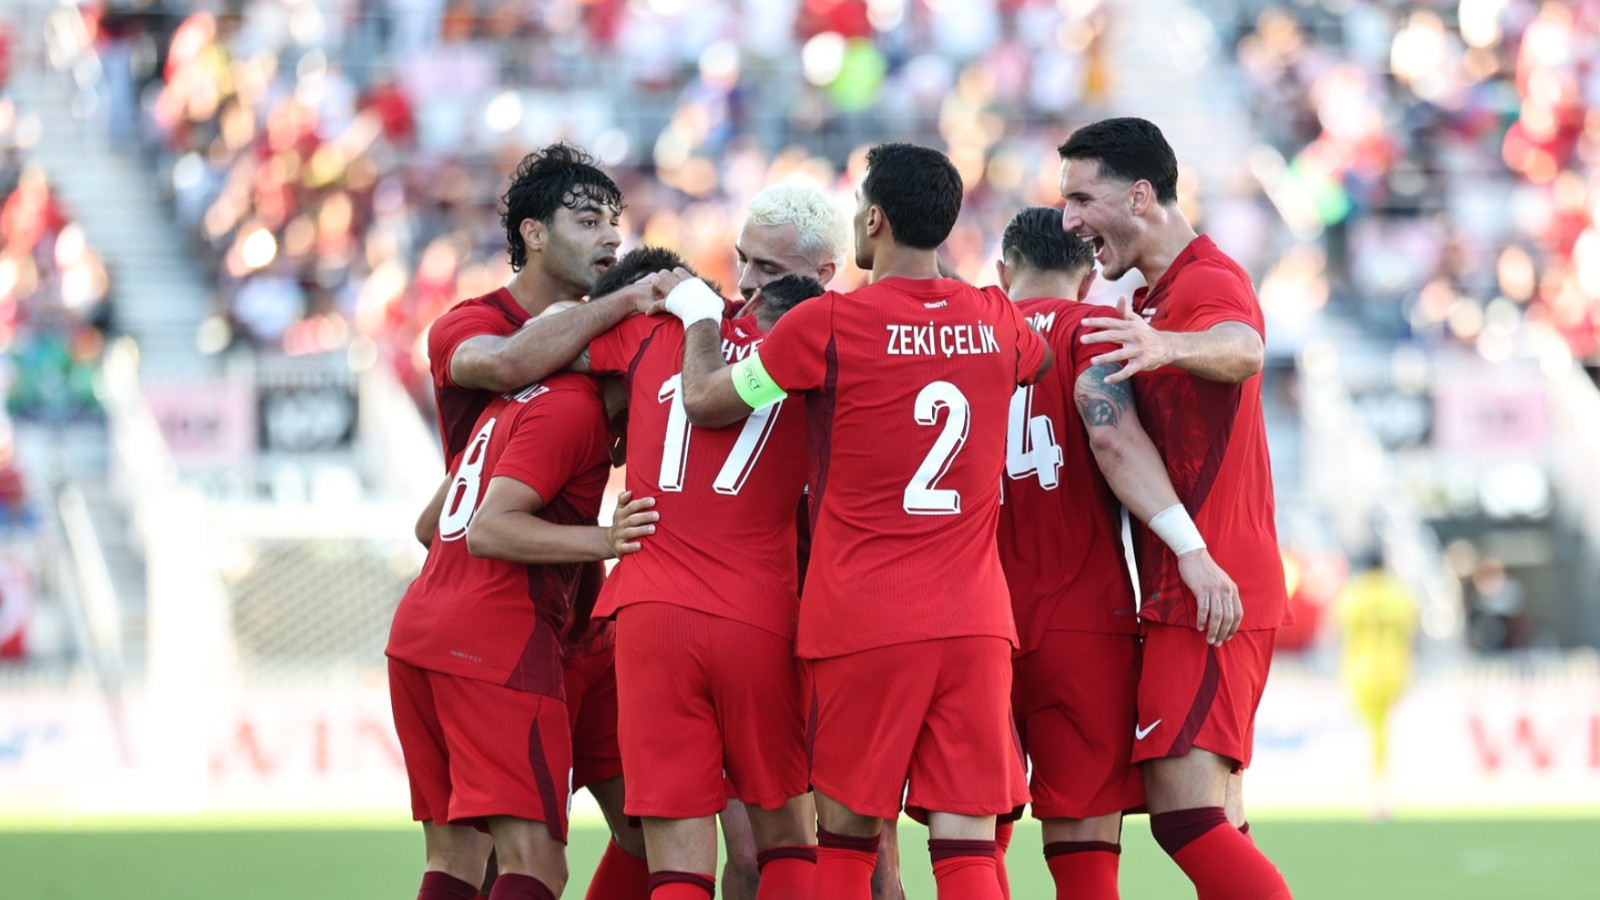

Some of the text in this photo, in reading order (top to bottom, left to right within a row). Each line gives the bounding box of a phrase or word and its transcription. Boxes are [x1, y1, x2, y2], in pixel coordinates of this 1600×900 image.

[886, 319, 1000, 358] ZEKİ ÇELİK
[439, 417, 497, 541] 8
[658, 372, 784, 495] 17
[903, 380, 971, 516] 2
[1000, 385, 1064, 505] 4
